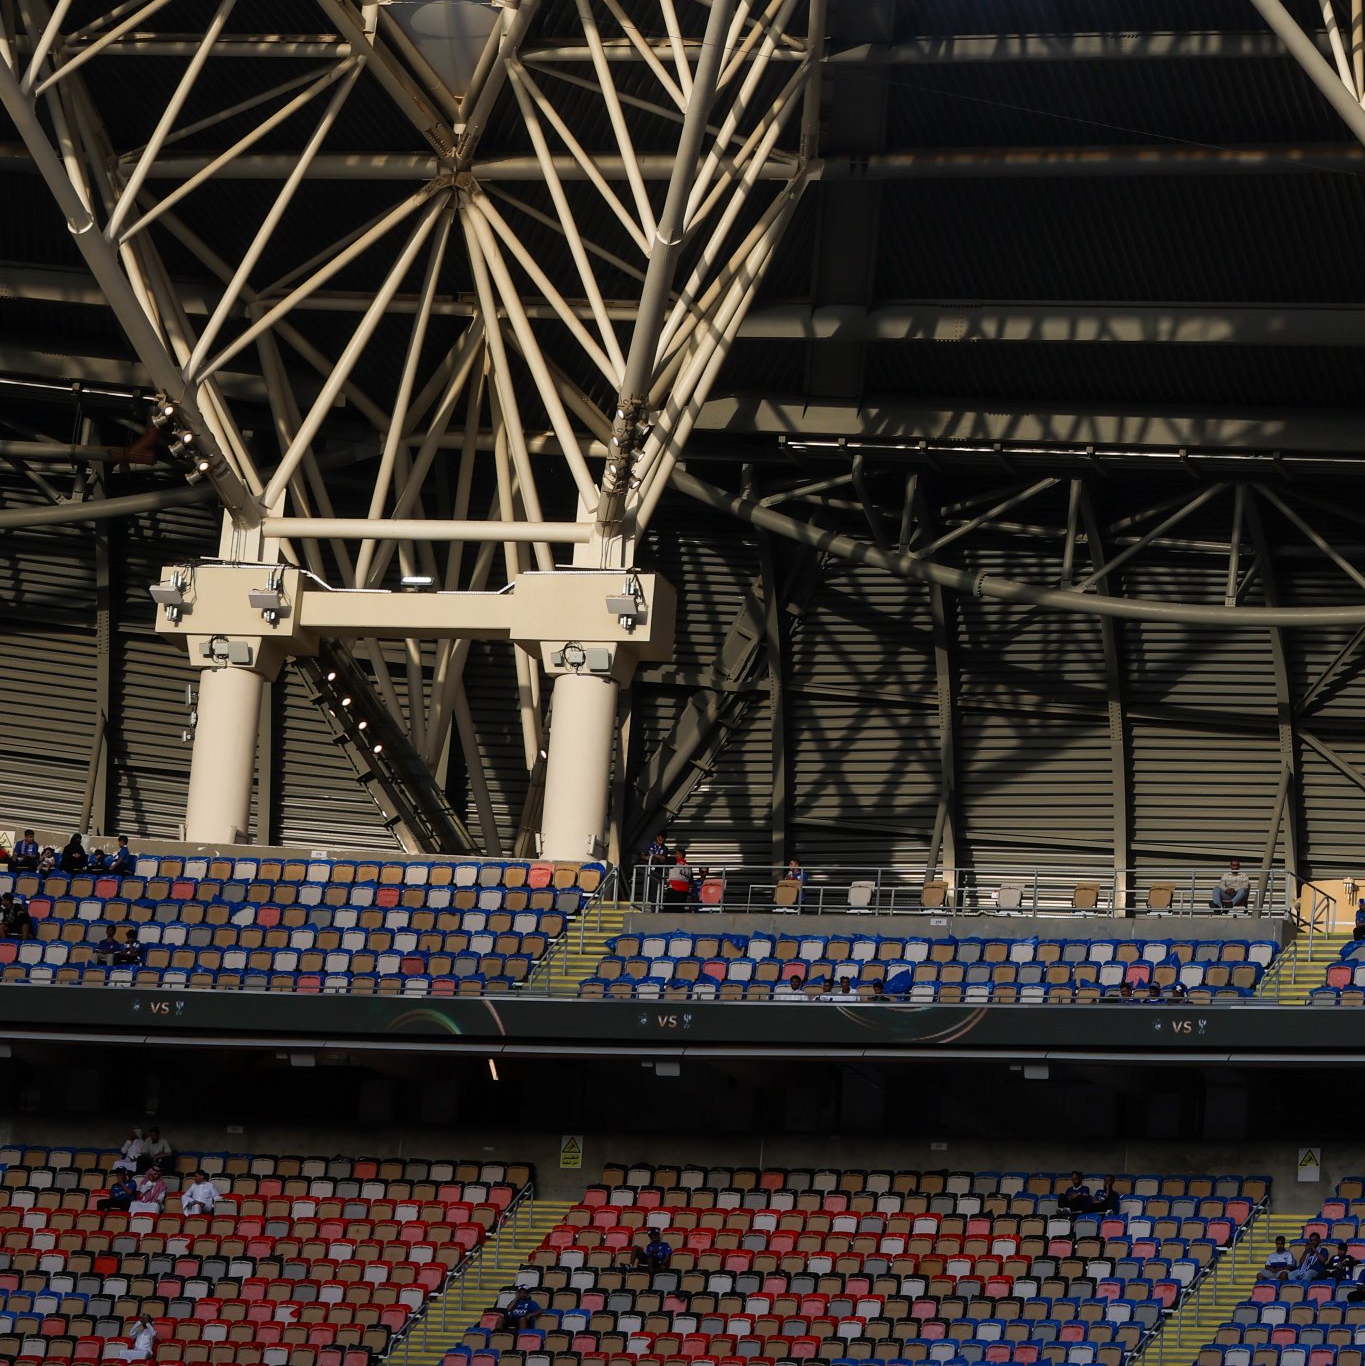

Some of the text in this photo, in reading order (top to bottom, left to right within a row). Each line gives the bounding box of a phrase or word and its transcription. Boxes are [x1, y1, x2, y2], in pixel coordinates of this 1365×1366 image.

[150, 1001, 170, 1014] VS
[658, 1014, 677, 1027] VS
[1172, 1021, 1192, 1033] VS
